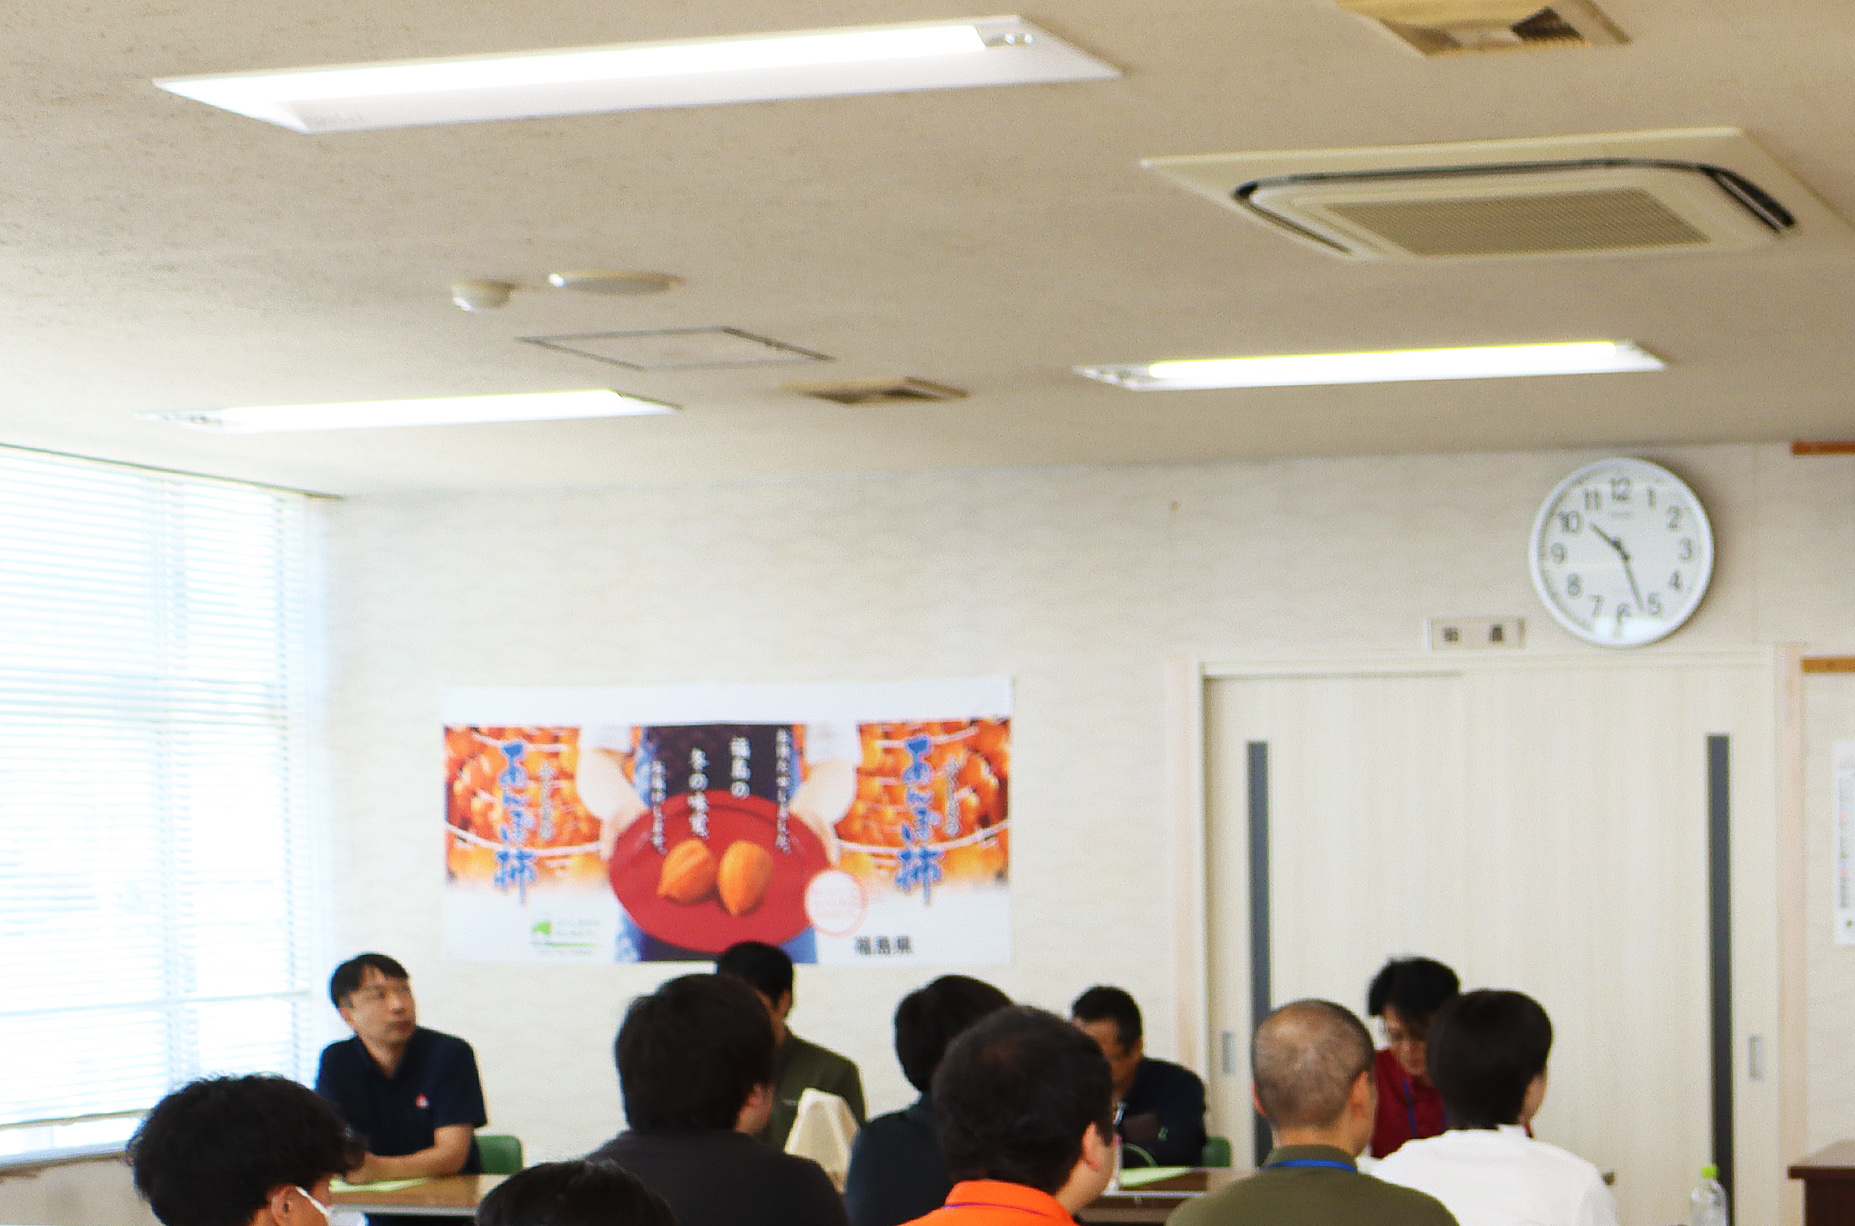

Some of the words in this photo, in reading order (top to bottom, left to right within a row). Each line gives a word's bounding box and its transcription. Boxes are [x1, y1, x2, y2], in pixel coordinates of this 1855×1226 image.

[1611, 478, 1631, 500] 12
[1647, 488, 1655, 506] 1
[1584, 491, 1601, 510] 11
[1558, 511, 1583, 533] 10
[1667, 506, 1681, 530] 2
[1551, 543, 1565, 564] 9
[1680, 538, 1692, 560] 3
[1568, 574, 1581, 597] 8
[1669, 570, 1681, 591] 4
[1589, 595, 1603, 618] 7
[1648, 593, 1661, 616] 5
[857, 935, 912, 956] 福島県
